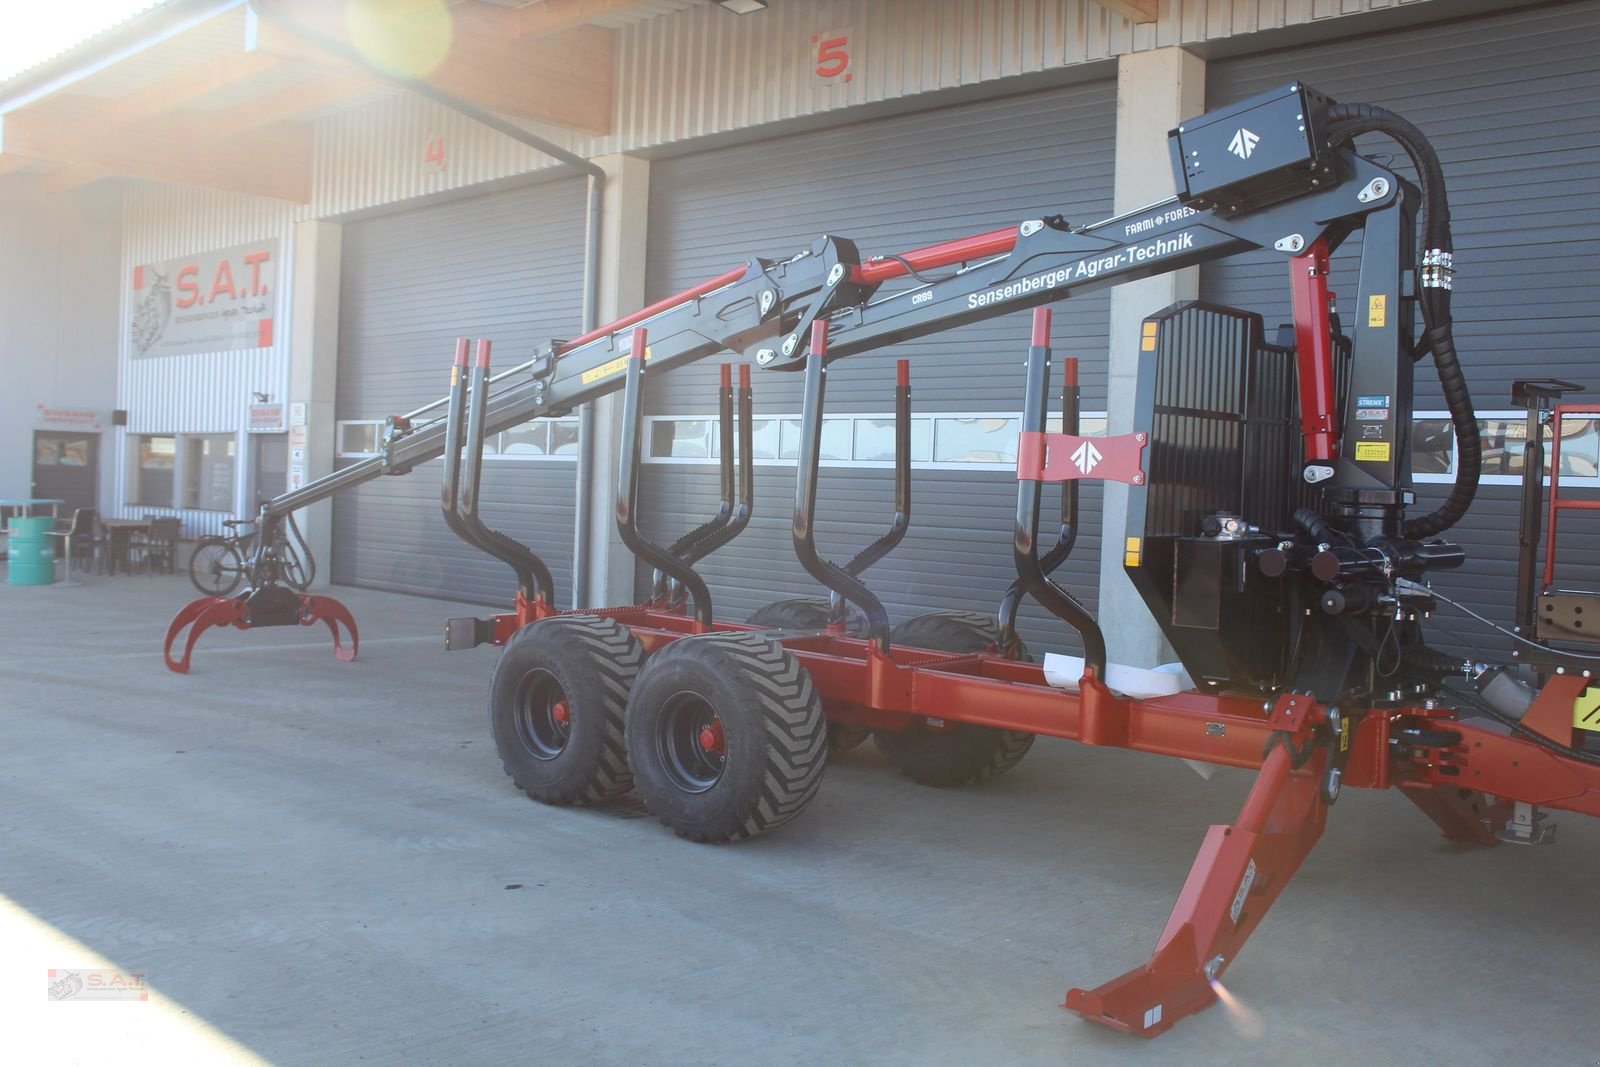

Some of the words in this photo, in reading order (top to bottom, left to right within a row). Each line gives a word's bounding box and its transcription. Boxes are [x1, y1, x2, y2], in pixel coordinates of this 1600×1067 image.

[816, 36, 849, 77] 5
[425, 137, 446, 165] 4
[1125, 218, 1154, 236] FARMI
[1165, 206, 1200, 223] FORES
[175, 251, 270, 309] S.A.T.
[968, 267, 1072, 309] Sensenberger
[1075, 232, 1193, 277] Agrar-Technik
